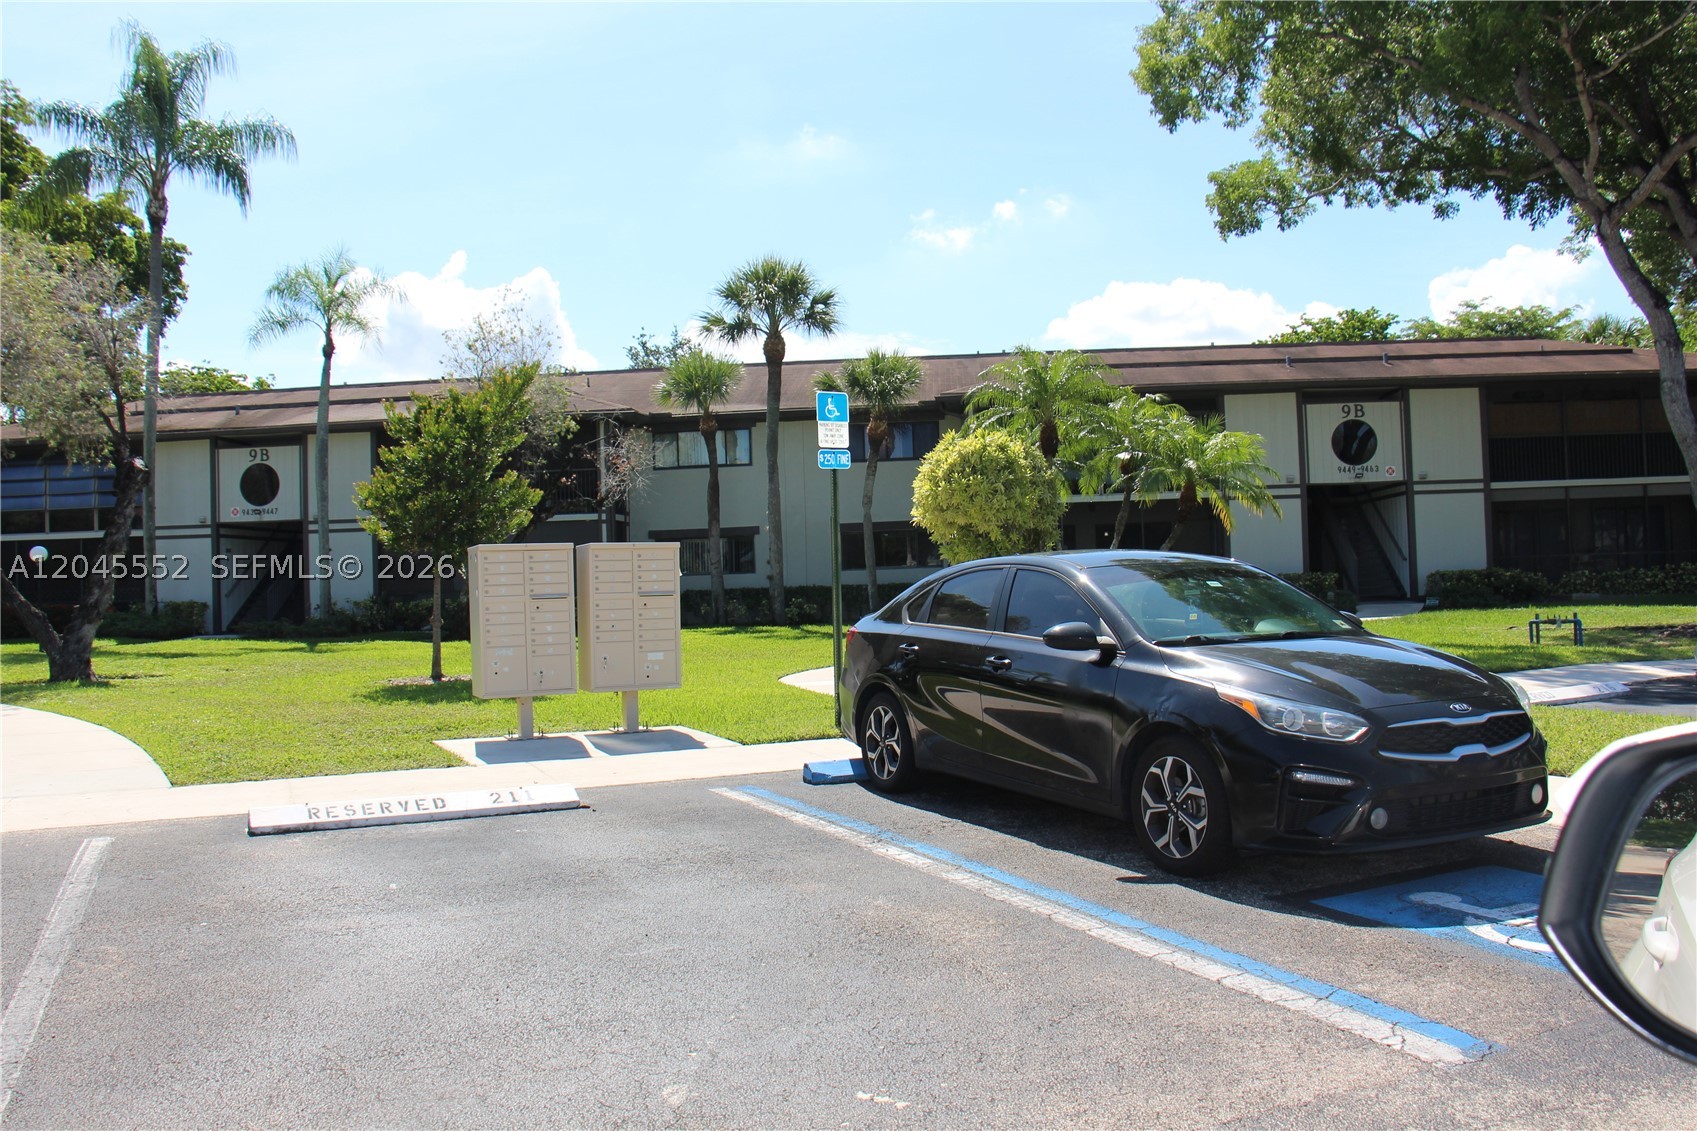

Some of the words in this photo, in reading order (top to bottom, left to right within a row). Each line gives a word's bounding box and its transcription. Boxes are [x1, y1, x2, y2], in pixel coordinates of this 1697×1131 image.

[1342, 404, 1365, 418] 9B
[249, 448, 270, 462] 9B
[820, 453, 835, 465] $250
[837, 453, 849, 465] FINE
[307, 797, 447, 820] RESERVED
